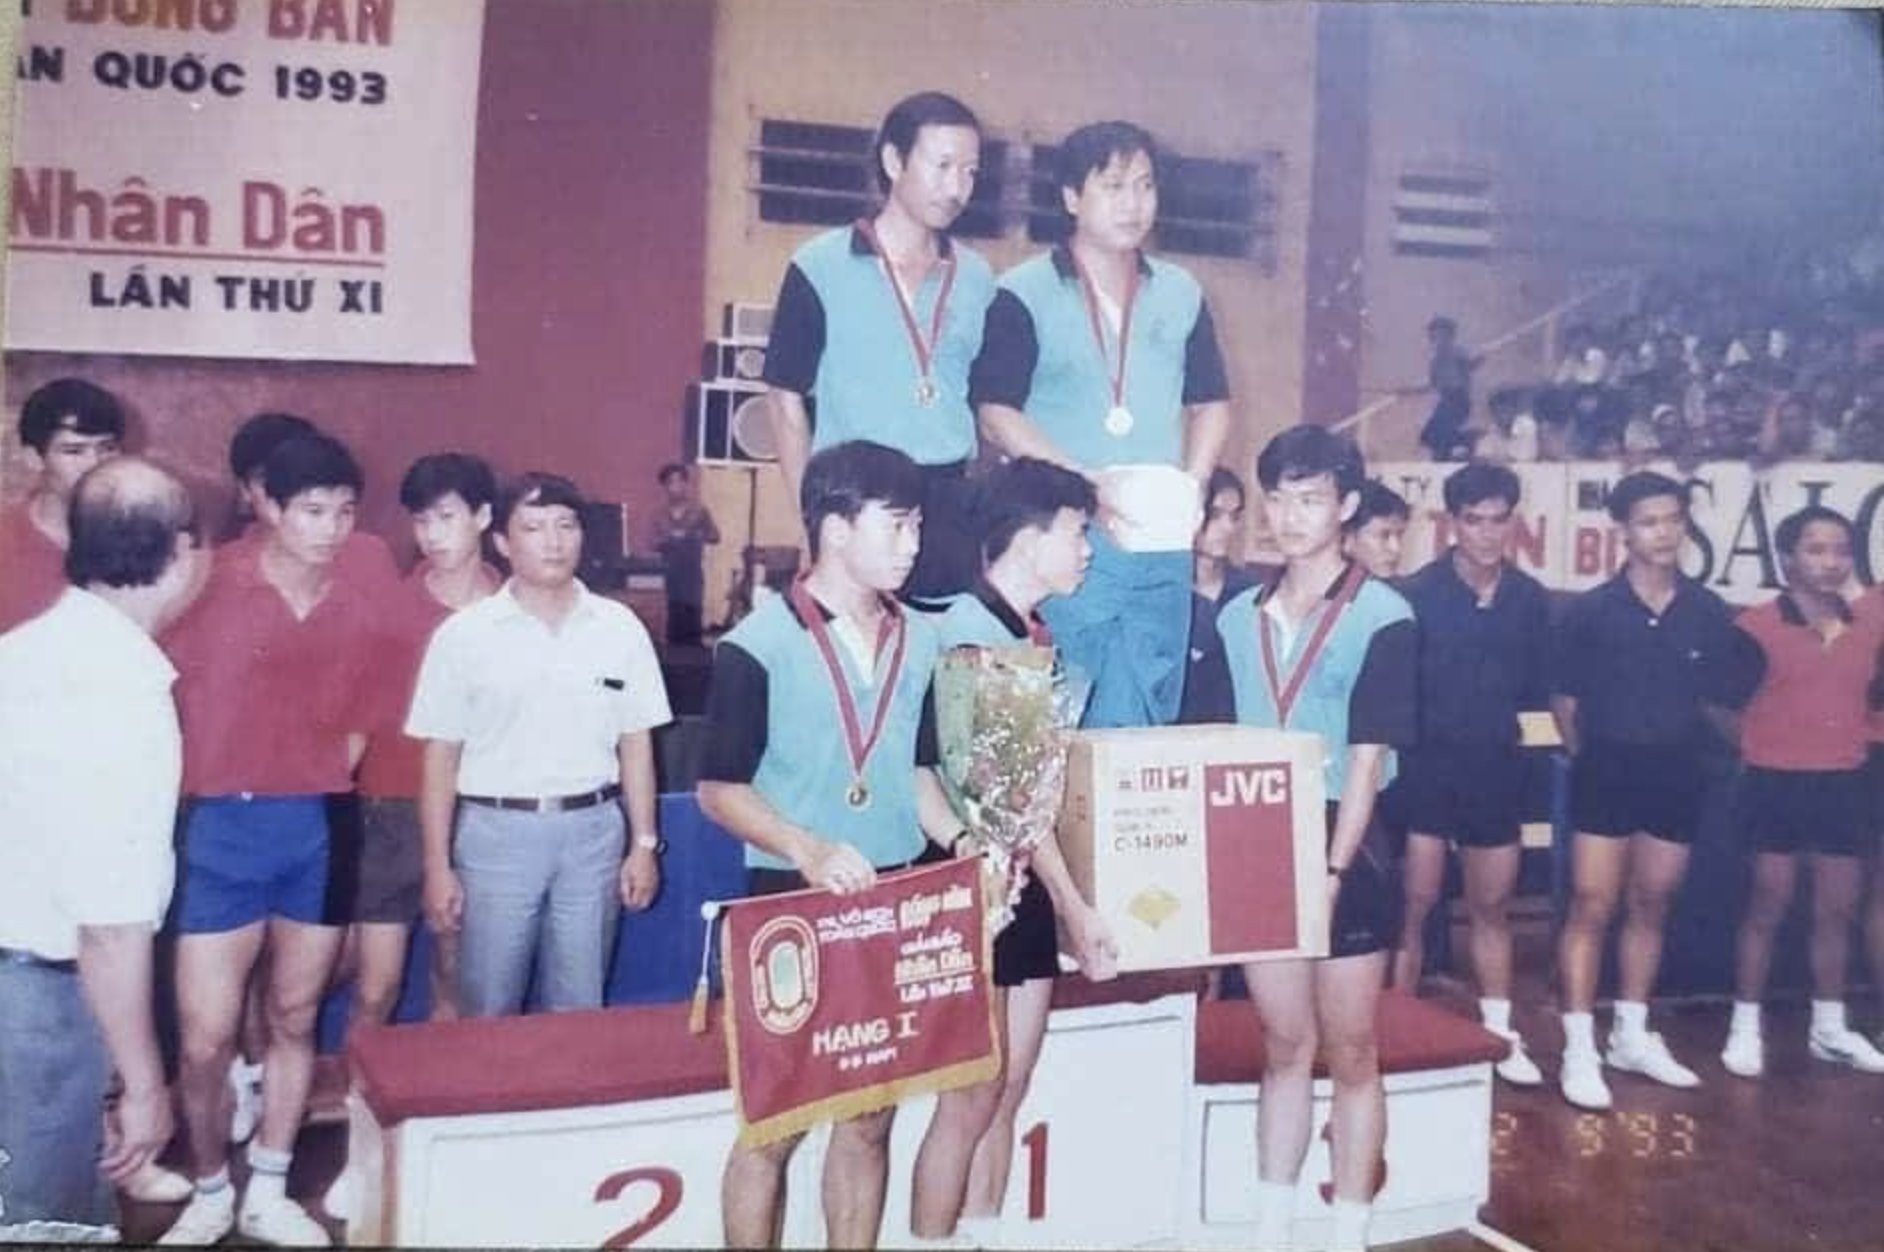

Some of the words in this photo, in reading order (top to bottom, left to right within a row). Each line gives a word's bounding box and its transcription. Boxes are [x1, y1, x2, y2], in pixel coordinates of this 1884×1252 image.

[275, 65, 387, 104] 1993
[11, 167, 210, 246] Nhân
[242, 180, 386, 253] Dân
[339, 280, 383, 313] XI
[1210, 768, 1288, 807] JVC
[1021, 1122, 1050, 1220] 1
[594, 1166, 684, 1249] 2
